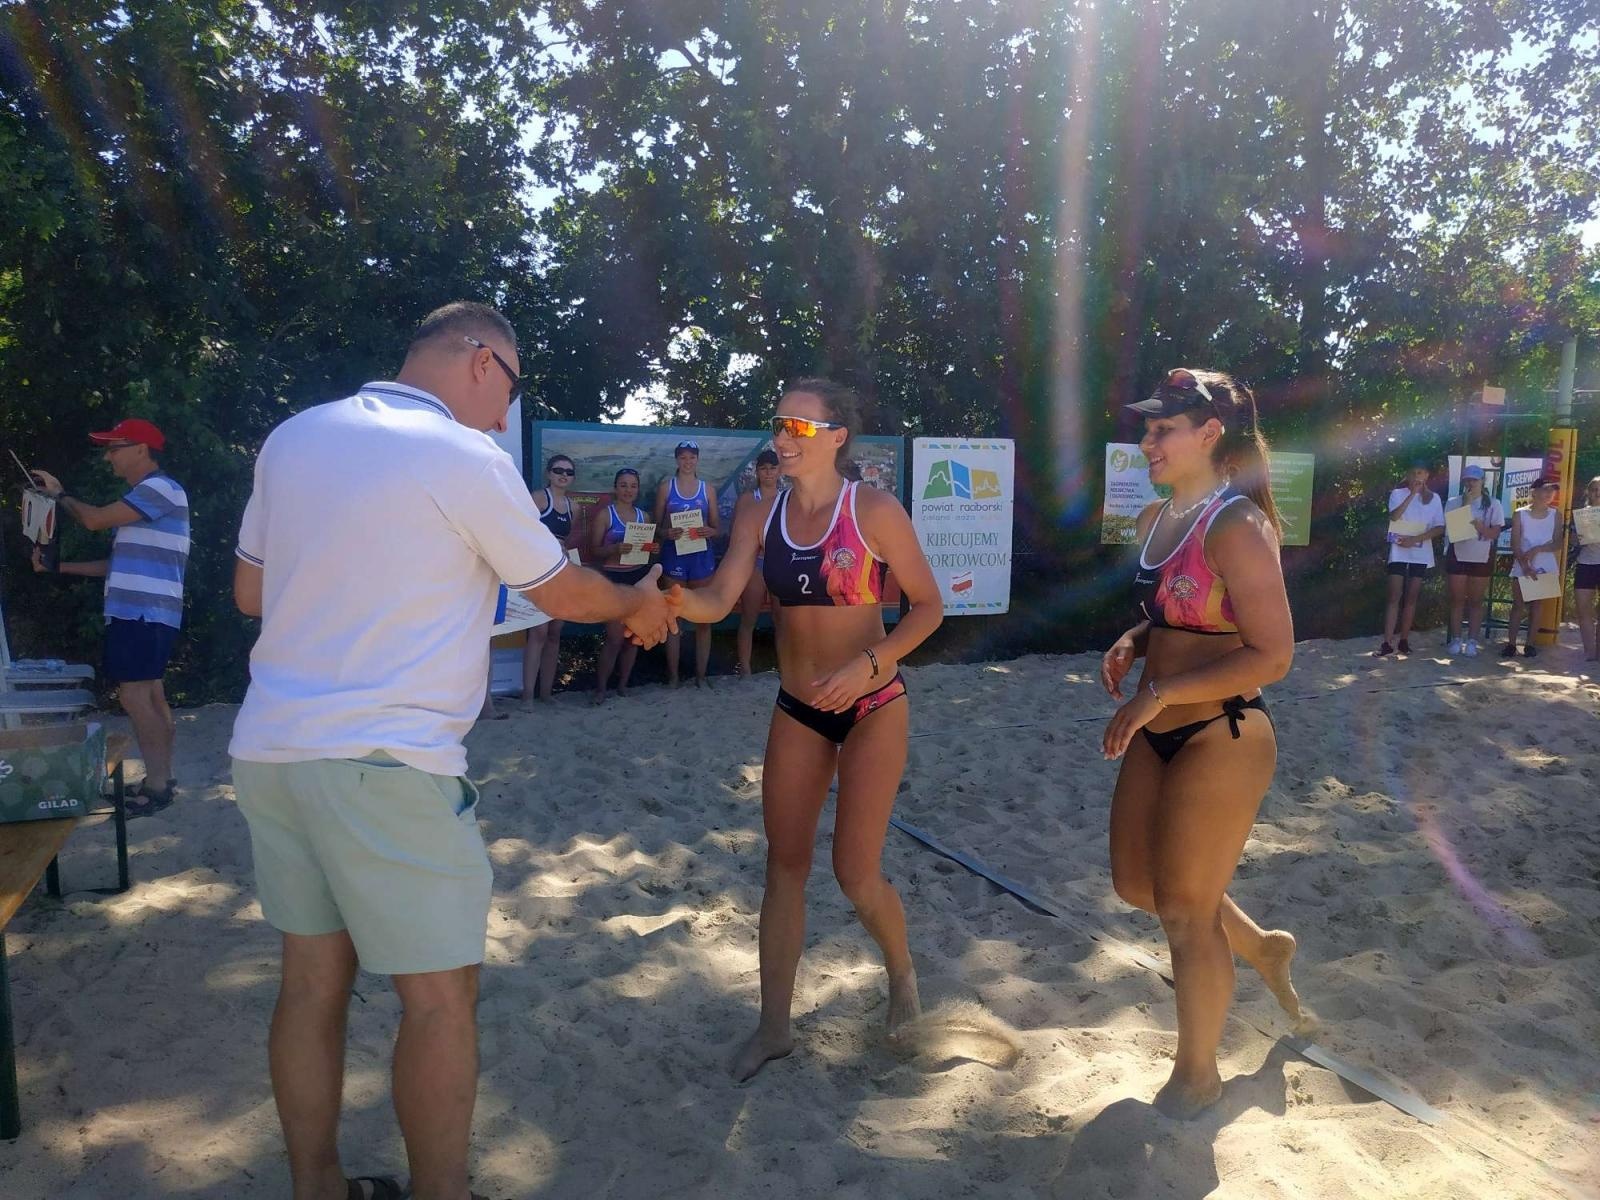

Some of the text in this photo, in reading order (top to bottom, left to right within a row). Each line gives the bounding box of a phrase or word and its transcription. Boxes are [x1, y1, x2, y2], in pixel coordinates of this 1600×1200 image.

[922, 502, 1003, 514] powiat raciborski
[673, 511, 700, 521] DYPLOM
[629, 524, 655, 532] DYPLOM
[926, 532, 999, 548] KIBICUJEMY
[924, 553, 1006, 568] PORTOWCOM
[797, 573, 813, 594] 2
[38, 798, 79, 809] GILAD
